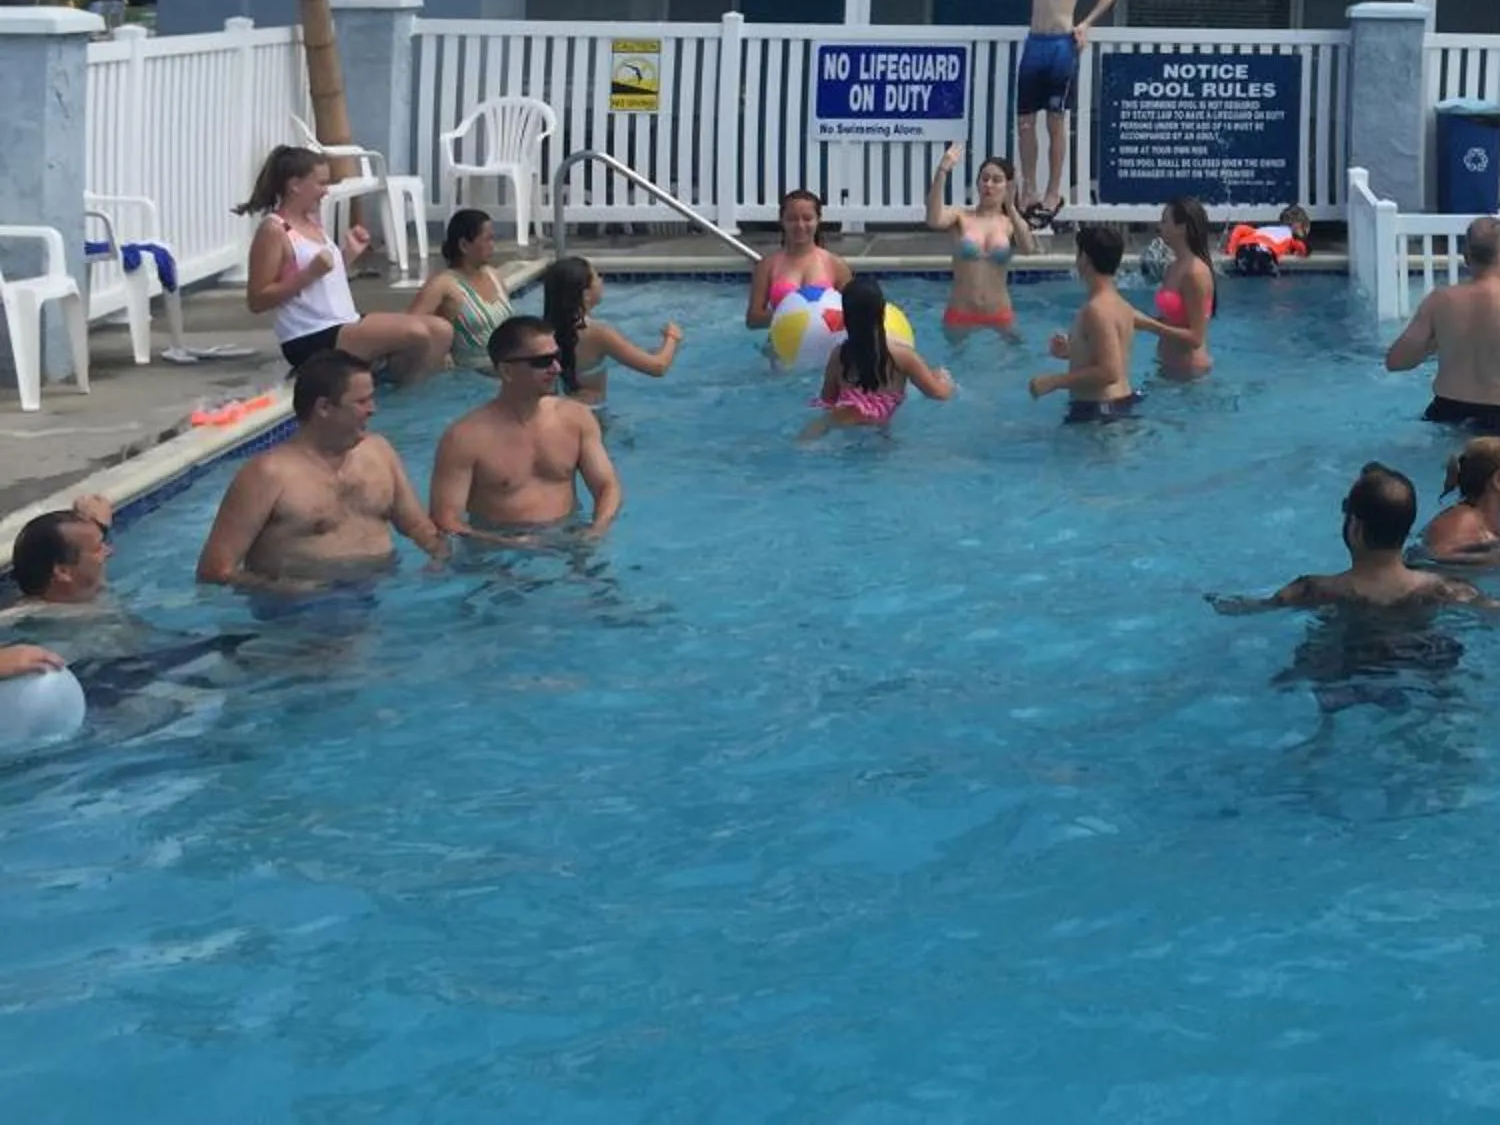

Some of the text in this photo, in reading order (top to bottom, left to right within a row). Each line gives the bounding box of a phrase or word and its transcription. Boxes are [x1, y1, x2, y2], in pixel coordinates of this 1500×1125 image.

[823, 52, 960, 81] NO LIFEGUARD
[1163, 63, 1249, 79] NOTICE
[849, 83, 933, 112] ON DUTY
[1133, 81, 1277, 98] POOL RULES
[819, 124, 834, 135] No
[837, 123, 890, 137] Swimming
